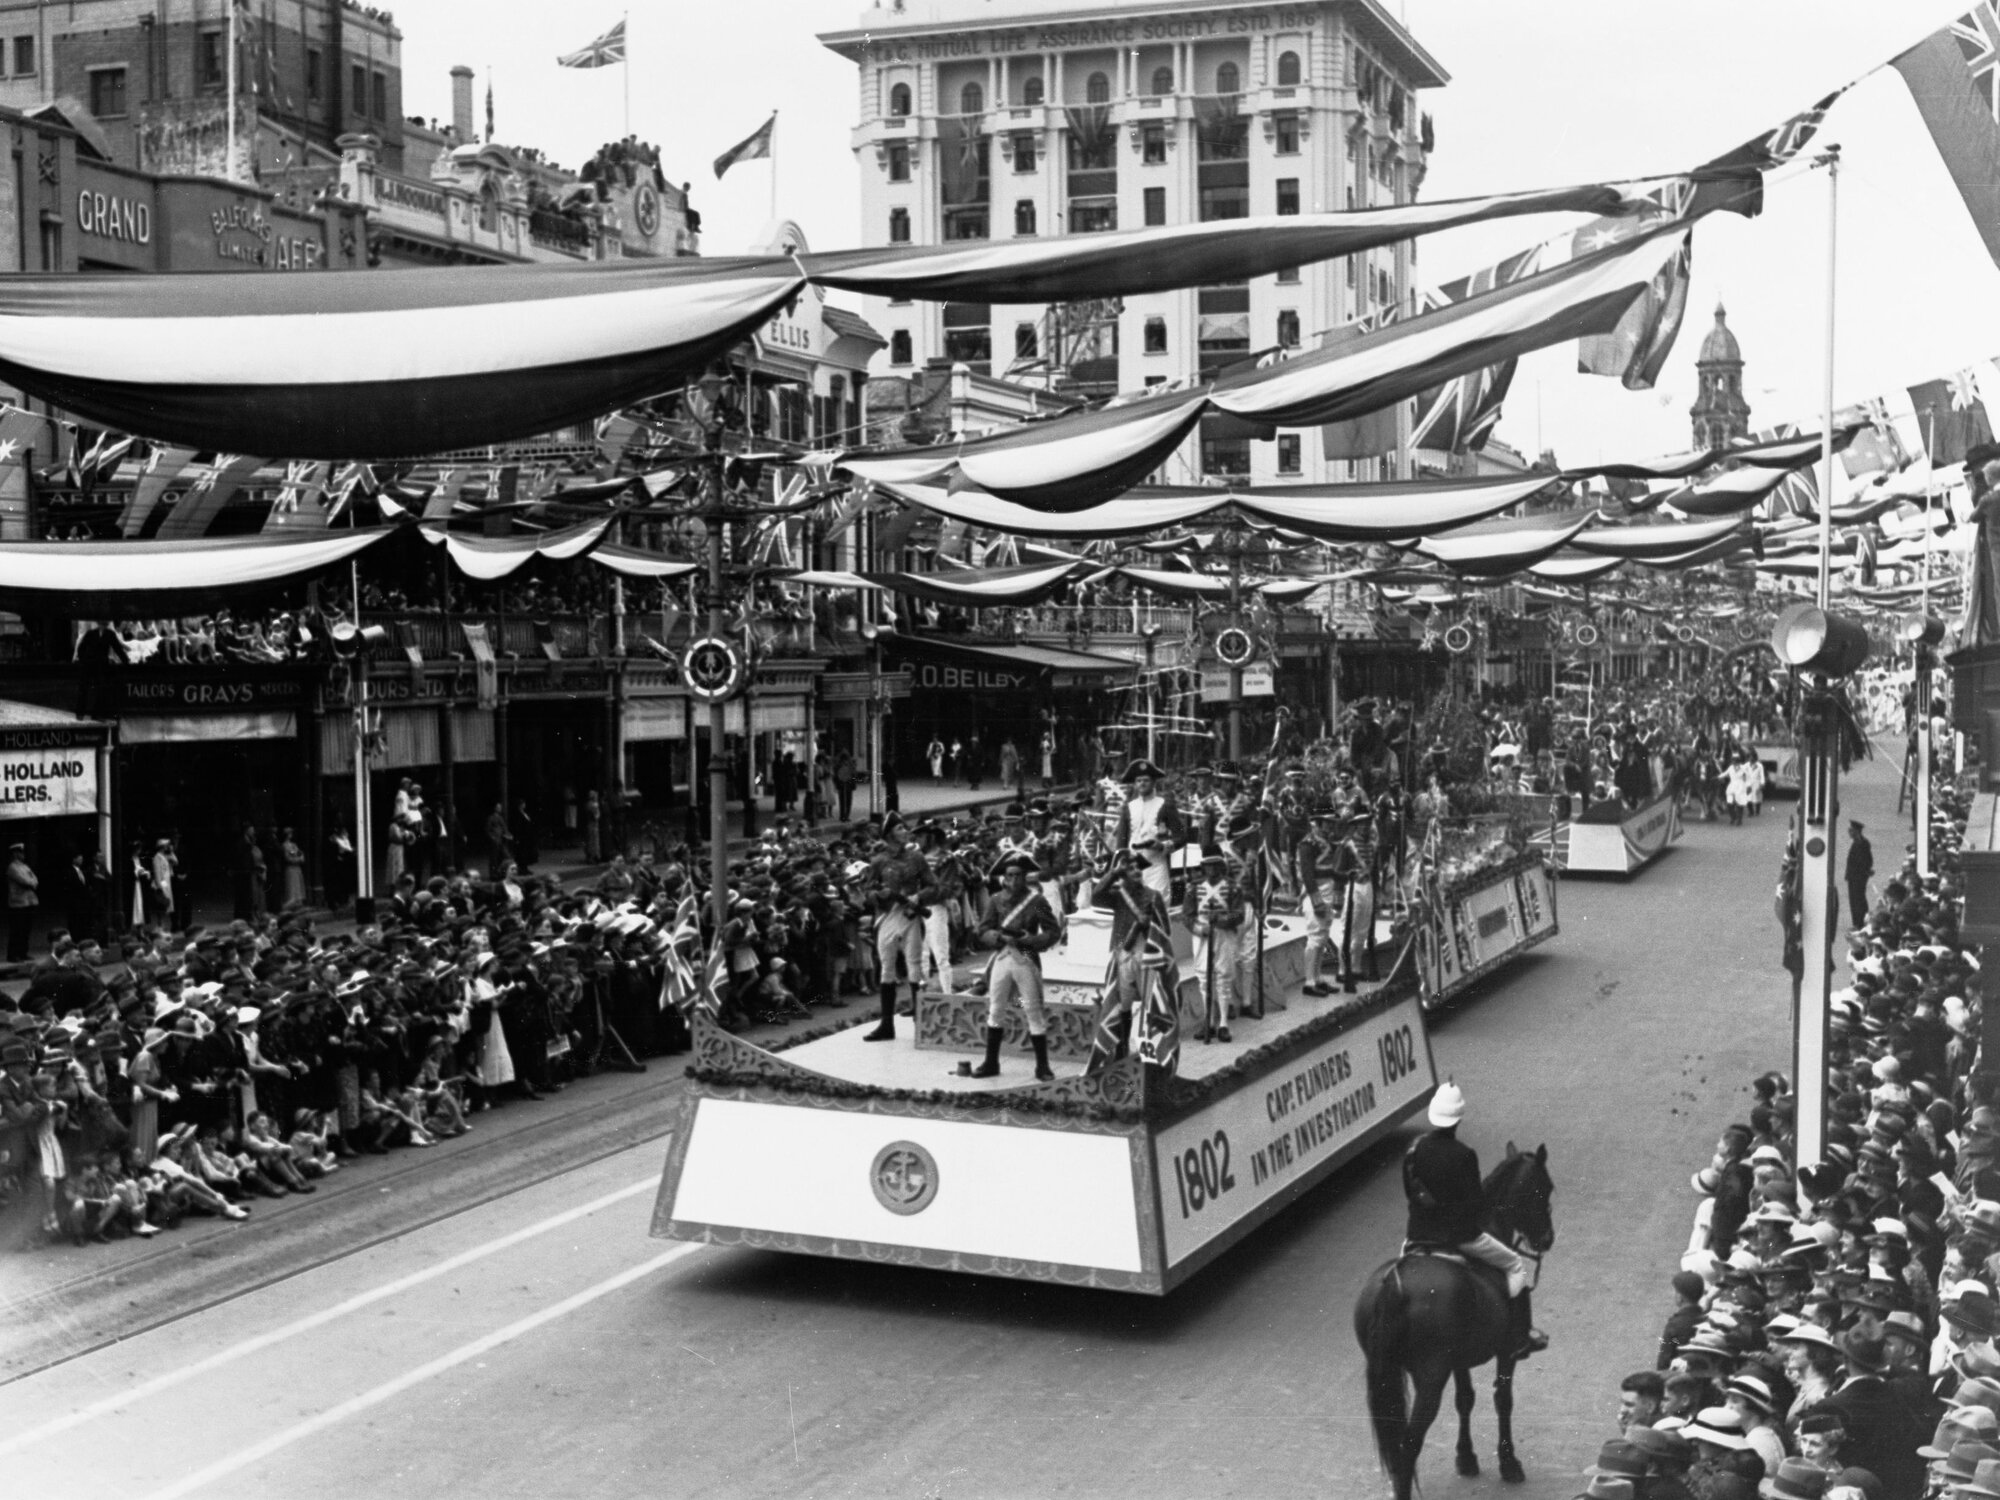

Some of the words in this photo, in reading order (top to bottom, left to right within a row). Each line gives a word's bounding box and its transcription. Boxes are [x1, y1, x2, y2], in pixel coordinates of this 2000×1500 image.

[918, 38, 981, 58] MUTUAL
[990, 33, 1027, 53] LIFE
[1036, 25, 1135, 50] ASSURANCE
[79, 189, 150, 245] GRAND
[770, 320, 810, 350] ELLIS
[126, 682, 176, 699] TAILORS
[183, 682, 254, 703] GRAYS
[5, 731, 72, 748] HOLLAND
[4, 760, 84, 781] HOLLAND
[1294, 1049, 1352, 1106] FLINDERS
[1377, 1024, 1416, 1087] 1802
[1250, 1149, 1269, 1187] IN
[1267, 1132, 1294, 1175] THE
[1294, 1081, 1377, 1158] INVESTIGATOR
[1174, 1129, 1236, 1219] 1802
